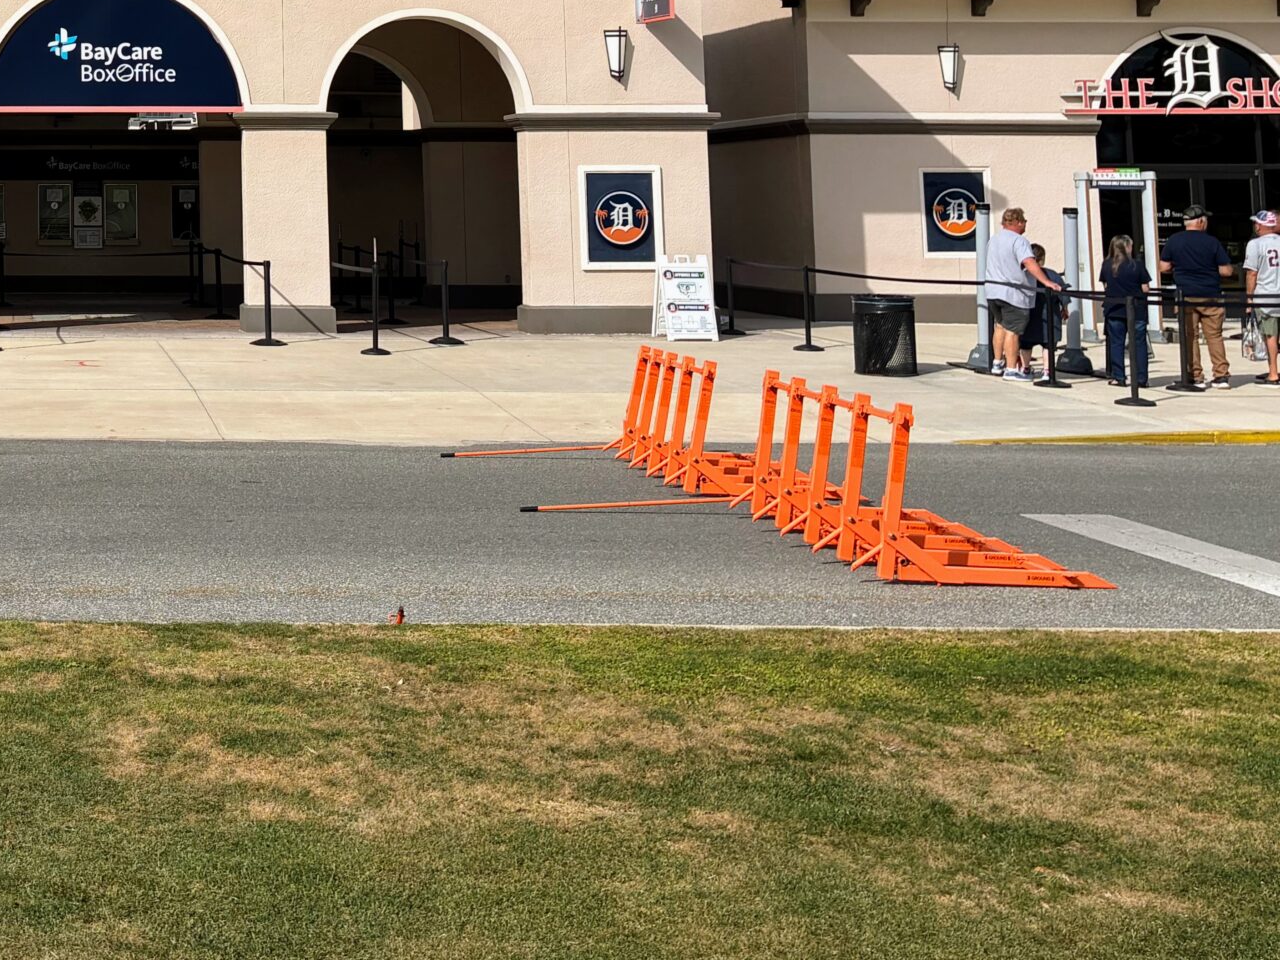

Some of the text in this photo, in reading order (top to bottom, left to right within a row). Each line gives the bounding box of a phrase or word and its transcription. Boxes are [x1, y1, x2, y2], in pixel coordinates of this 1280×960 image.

[80, 42, 163, 66] BayCare
[80, 63, 177, 83] BoxOffice
[1073, 77, 1159, 109] THE
[1158, 30, 1221, 117] D
[58, 162, 91, 171] BayCare
